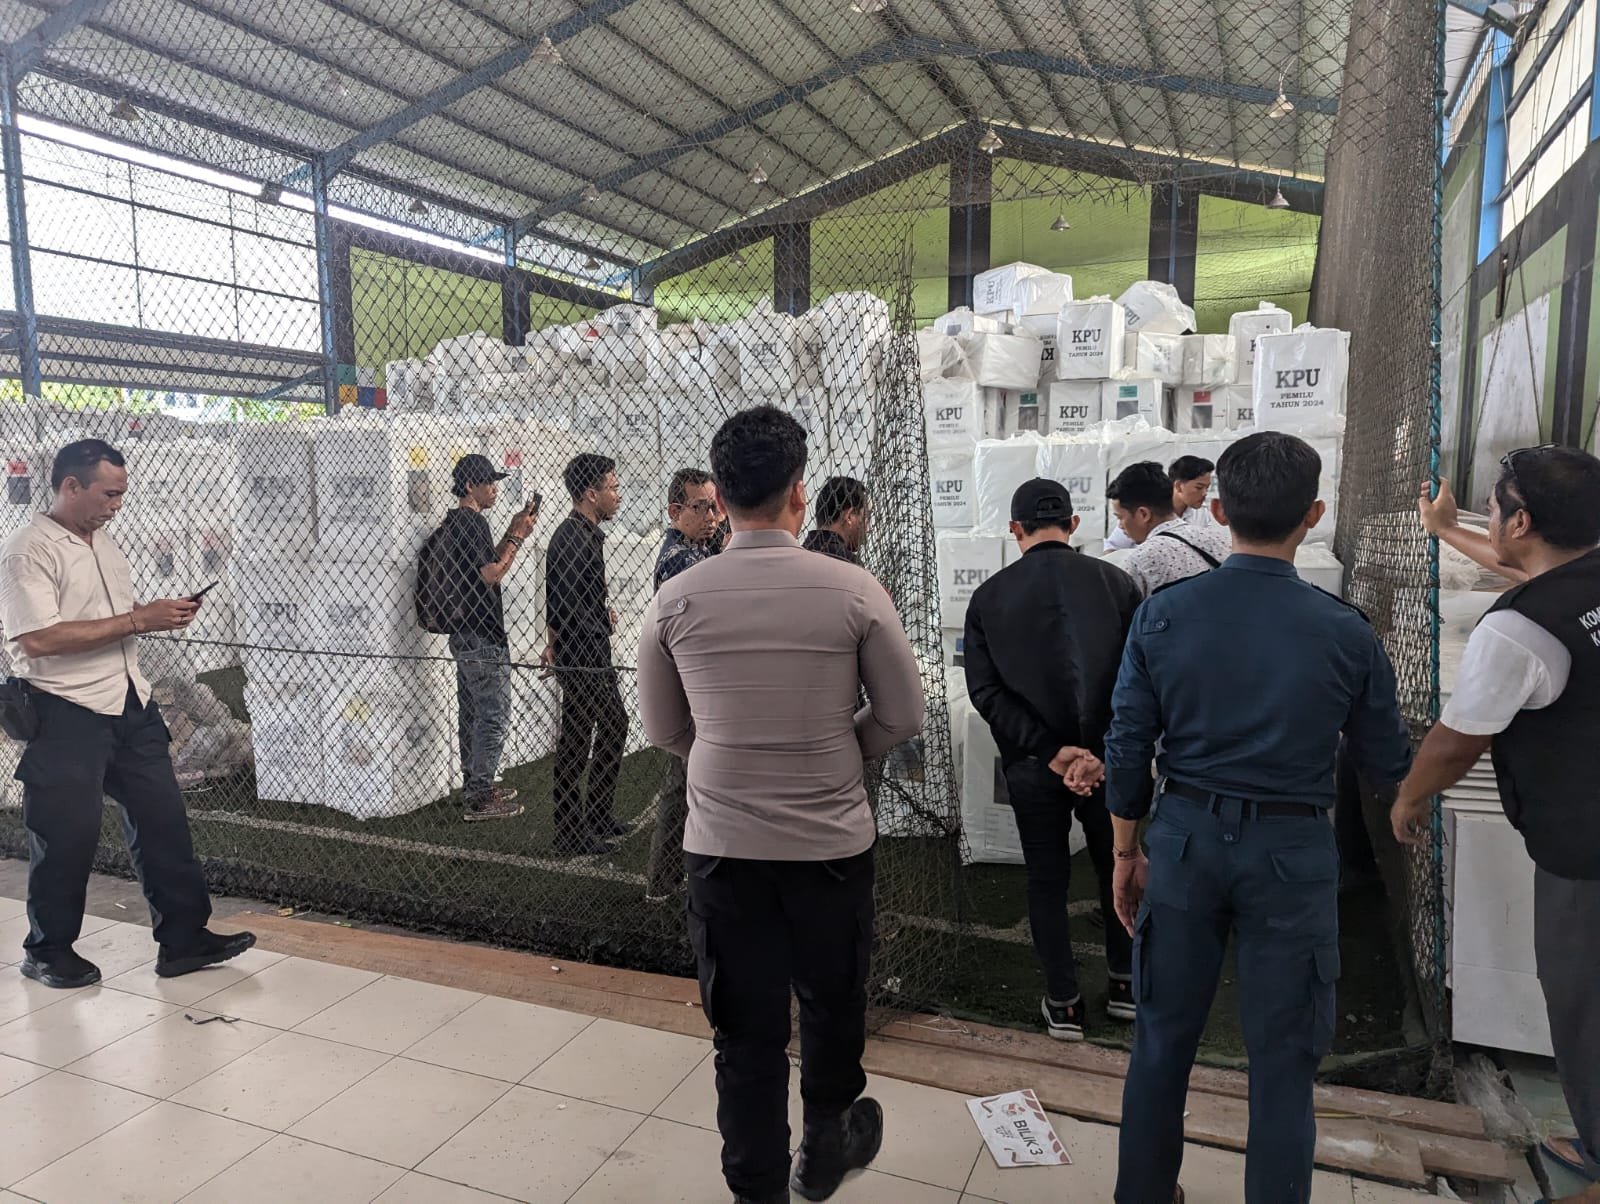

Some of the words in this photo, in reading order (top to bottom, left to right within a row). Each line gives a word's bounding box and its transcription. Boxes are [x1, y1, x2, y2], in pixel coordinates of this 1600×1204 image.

[1122, 303, 1141, 325] PU
[1072, 328, 1102, 343] KPU
[1275, 368, 1320, 388] KPU
[936, 407, 963, 420] KPU
[1059, 405, 1088, 418] KPU
[936, 480, 963, 493] KPU
[1059, 476, 1093, 494] PU
[953, 569, 989, 585] KPU
[1013, 1120, 1039, 1147] BILIK
